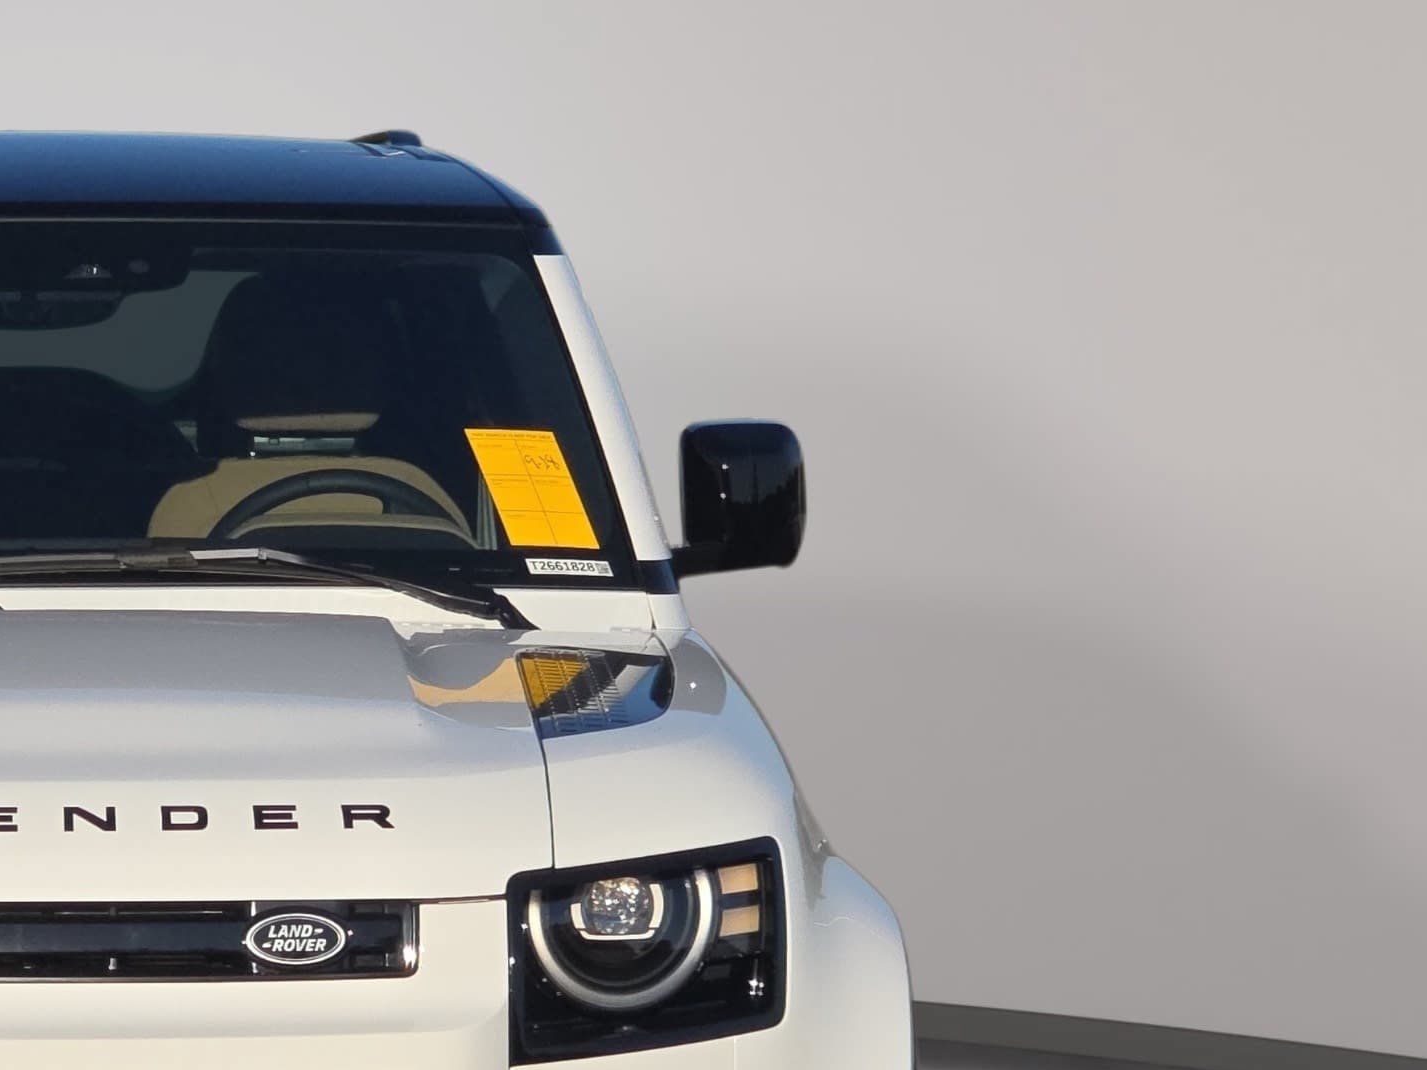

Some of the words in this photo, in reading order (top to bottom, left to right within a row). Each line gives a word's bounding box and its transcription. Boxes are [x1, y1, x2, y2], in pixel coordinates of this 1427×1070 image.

[528, 560, 596, 572] T2661828
[268, 924, 313, 938] LAND
[271, 938, 327, 952] ROVER
